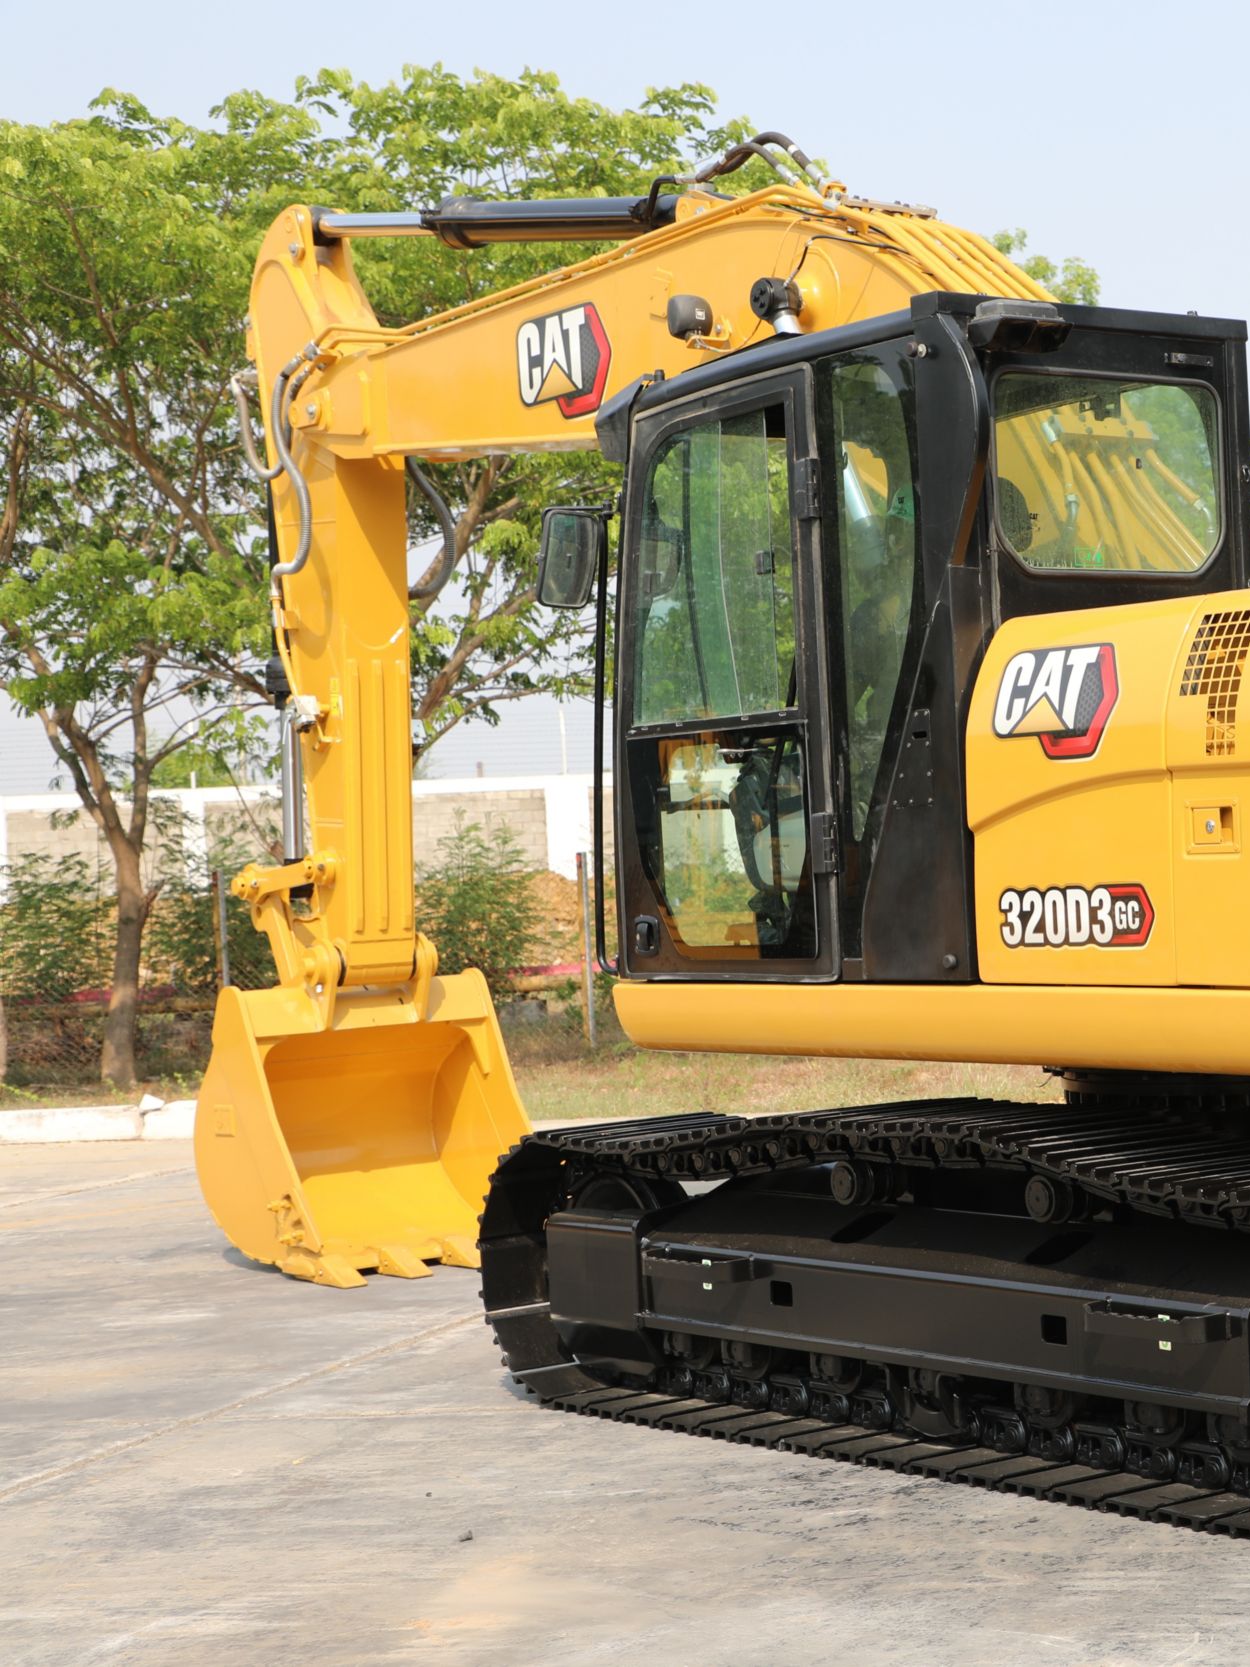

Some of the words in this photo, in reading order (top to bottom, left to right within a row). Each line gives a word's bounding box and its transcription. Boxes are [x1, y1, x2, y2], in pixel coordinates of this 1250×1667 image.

[518, 306, 585, 404] CAT
[994, 646, 1101, 735] CAT
[1001, 888, 1114, 945] 320D3
[1114, 900, 1140, 930] GC
